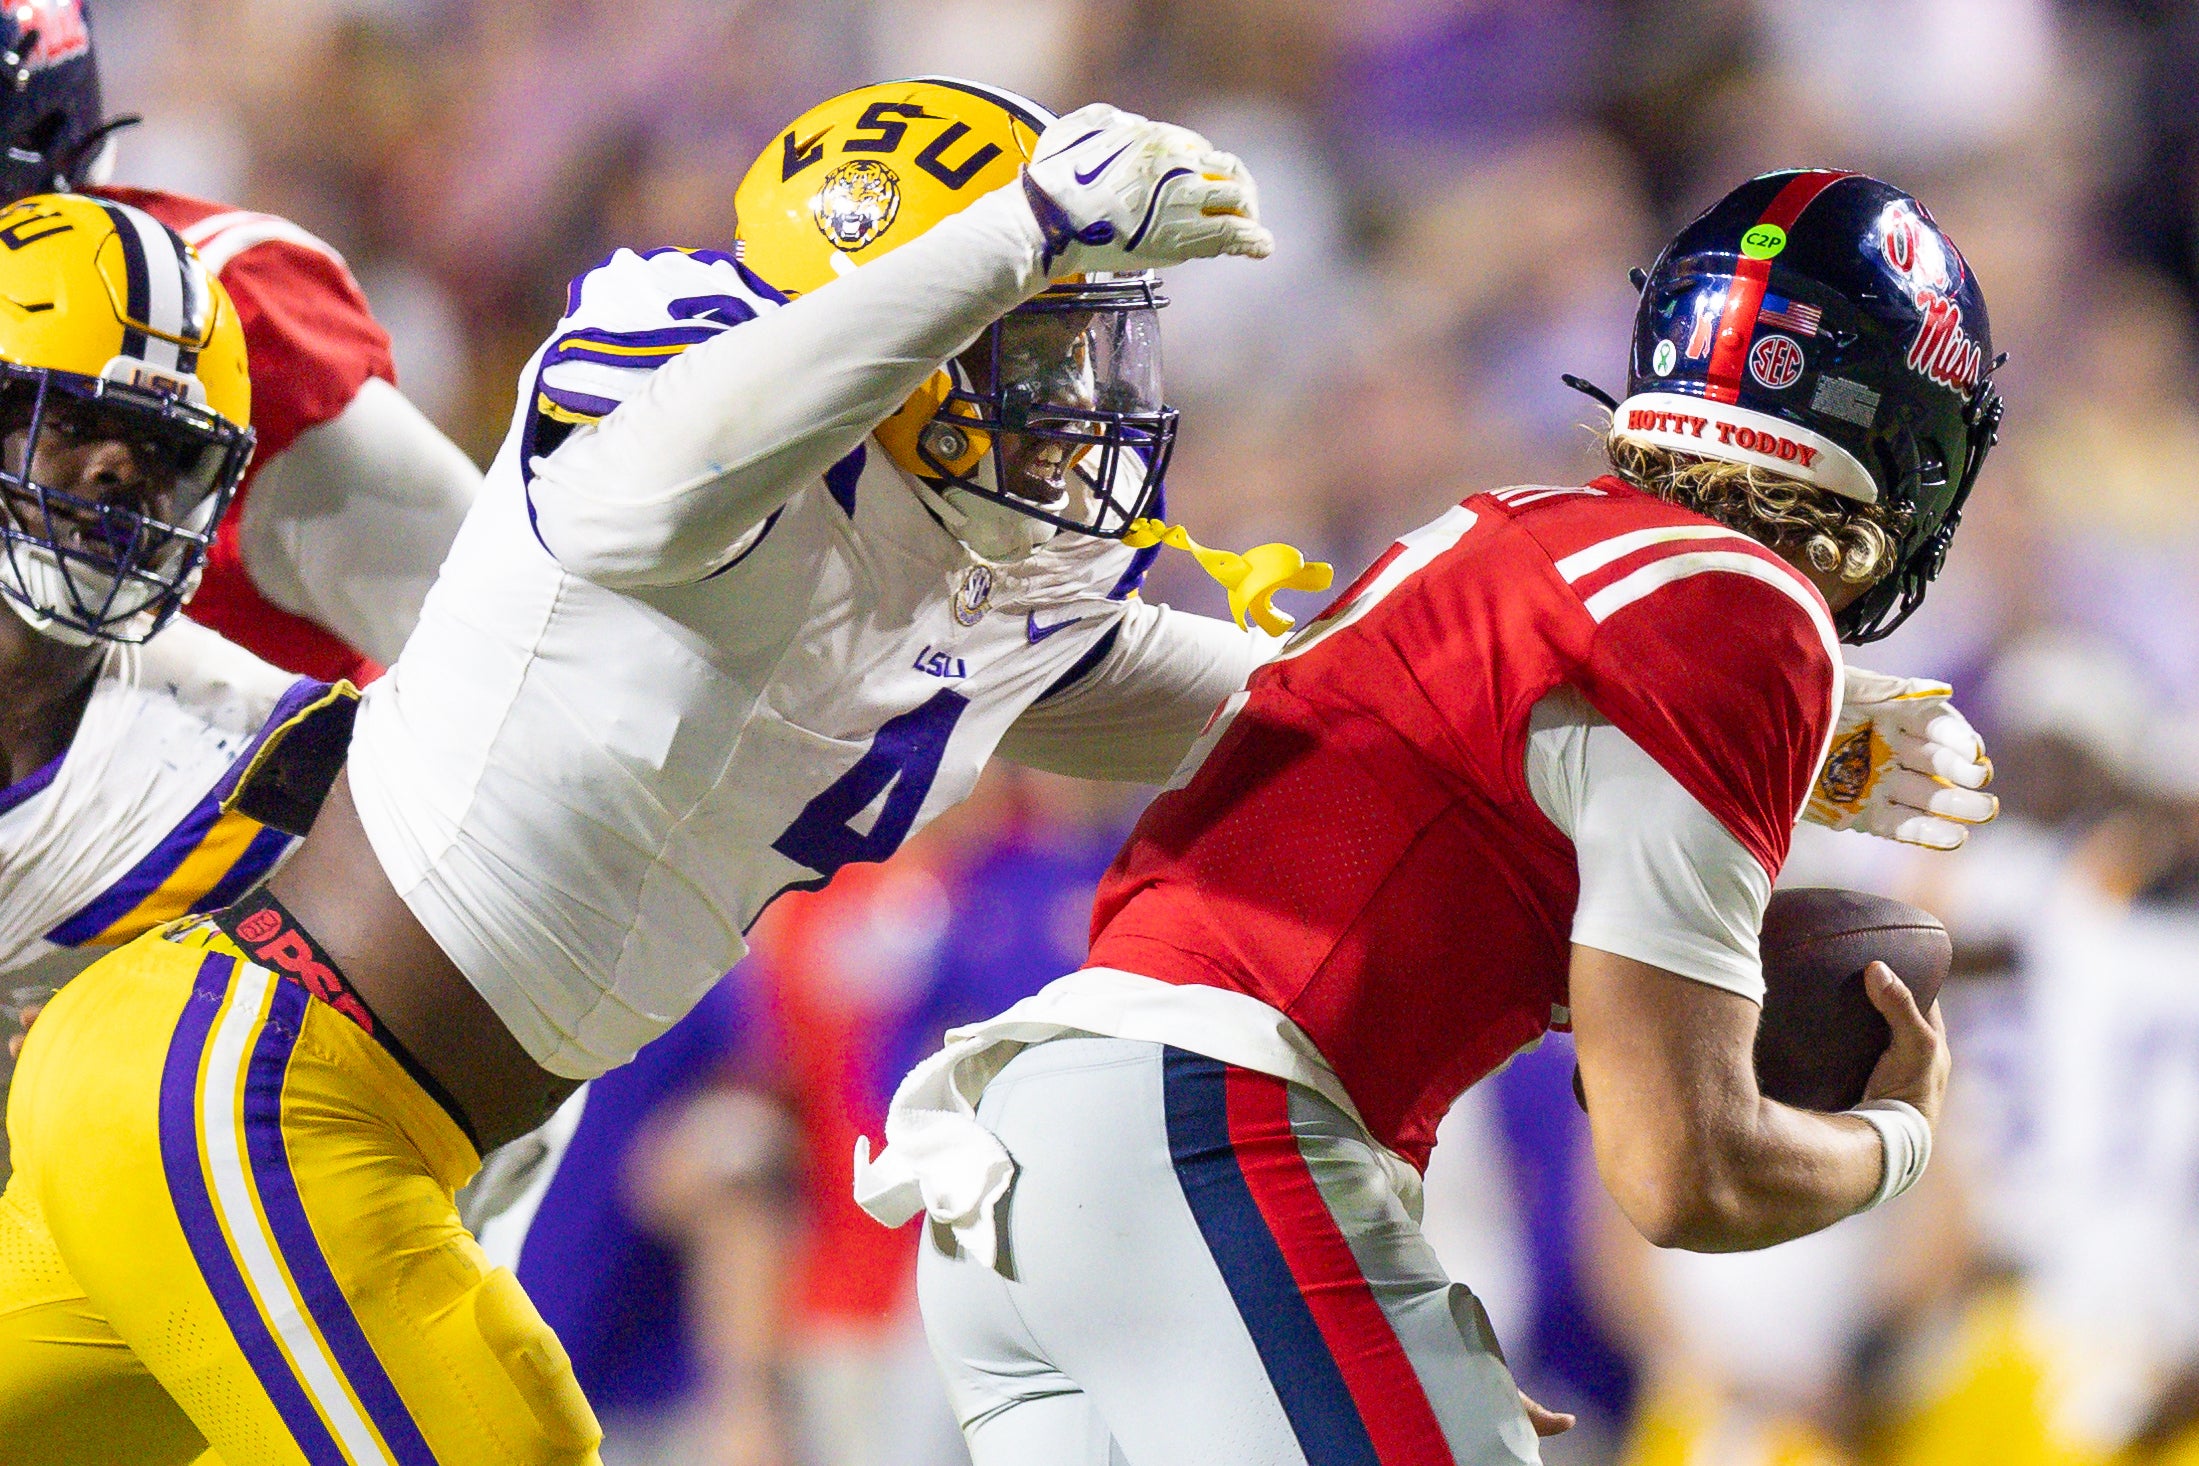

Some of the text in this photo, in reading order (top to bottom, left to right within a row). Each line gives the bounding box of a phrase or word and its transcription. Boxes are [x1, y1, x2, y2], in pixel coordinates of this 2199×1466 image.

[782, 102, 1003, 190] LSU
[1746, 232, 1782, 249] C2P
[1753, 338, 1800, 386] SEC
[1907, 290, 1981, 402] Miss
[1627, 409, 1818, 468] HOTTY TODDY
[912, 644, 967, 679] LSU
[769, 686, 972, 877] 4
